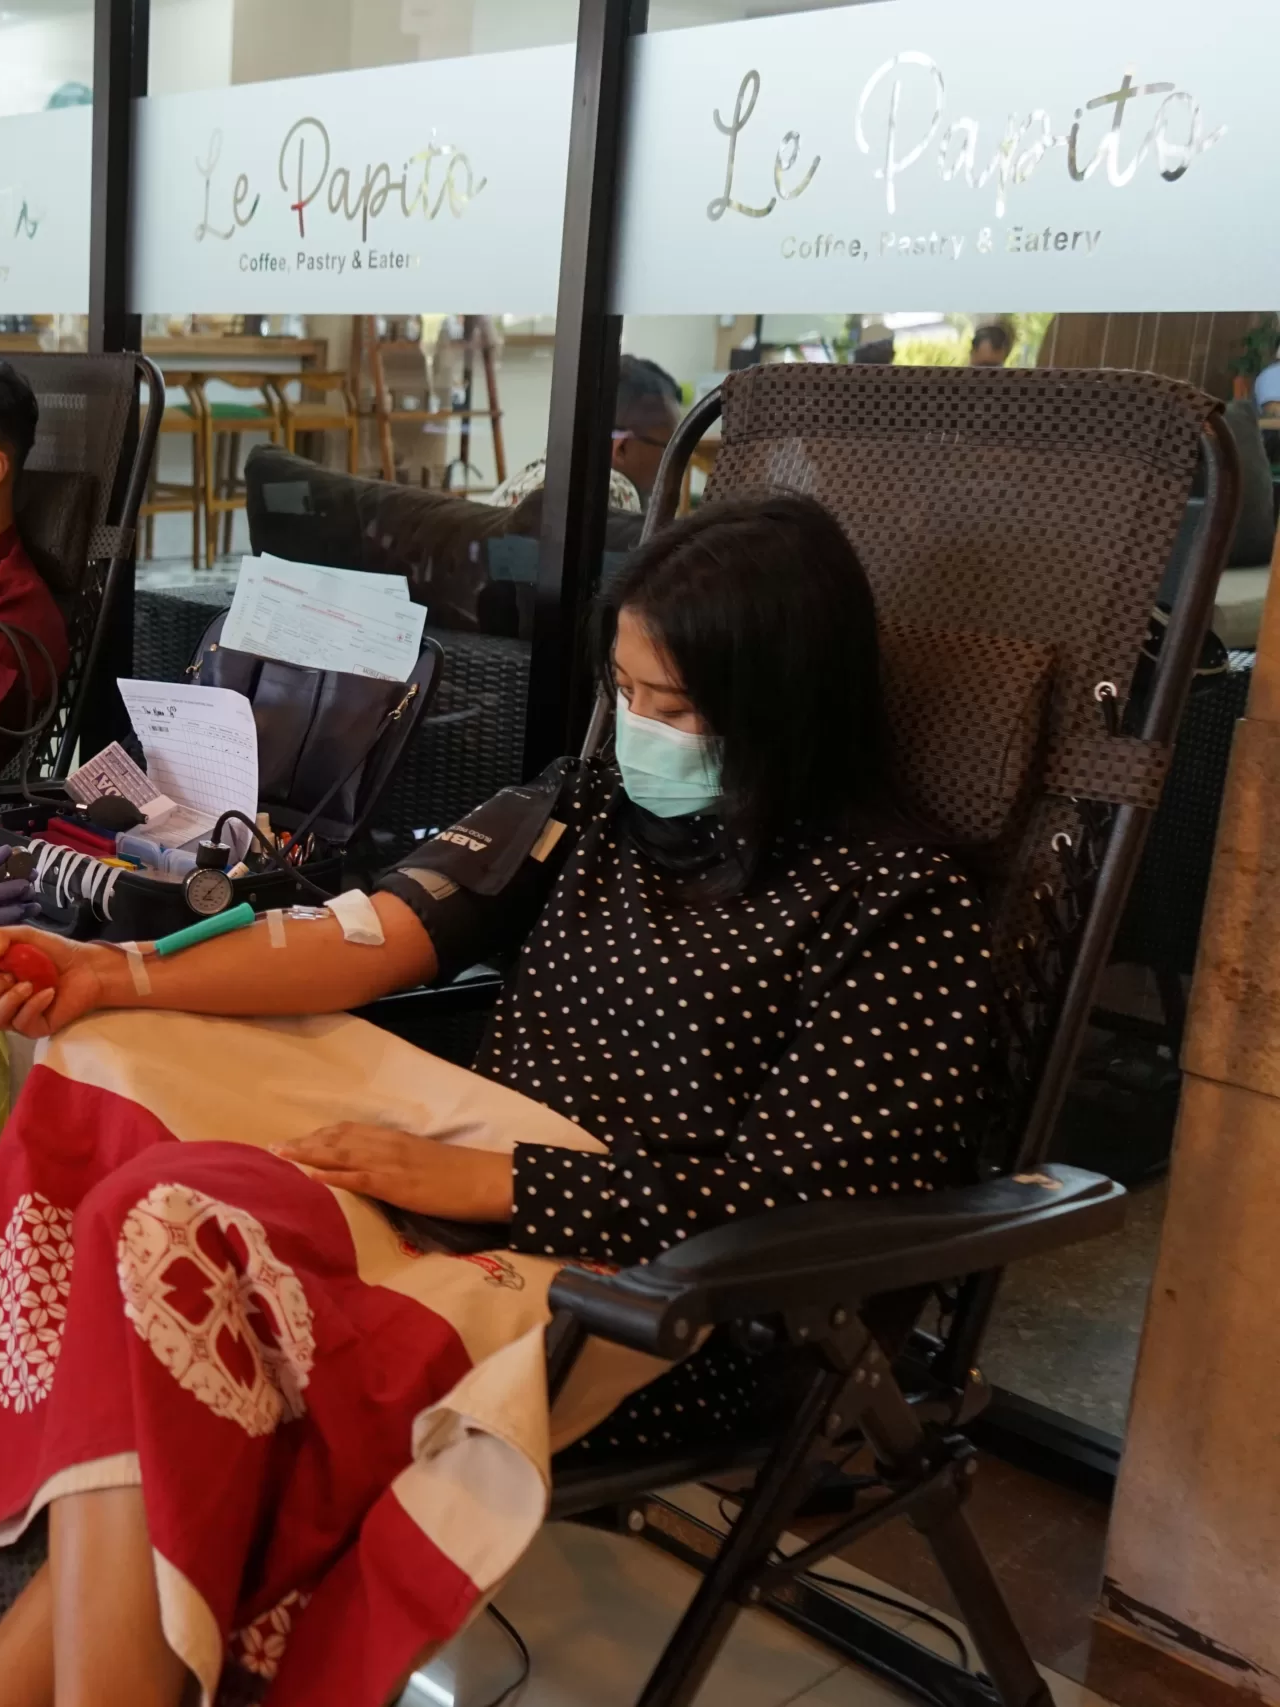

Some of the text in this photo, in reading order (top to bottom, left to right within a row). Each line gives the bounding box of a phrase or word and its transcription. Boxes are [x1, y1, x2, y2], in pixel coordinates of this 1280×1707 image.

[706, 50, 1228, 221] Le Papito
[193, 127, 261, 243] Le
[278, 115, 488, 243] Papito
[238, 252, 291, 274] Coffee,
[296, 252, 346, 274] Pastry
[351, 250, 362, 269] &
[879, 229, 964, 260] Pastry
[976, 226, 994, 253] &
[1006, 225, 1102, 255] Eatery
